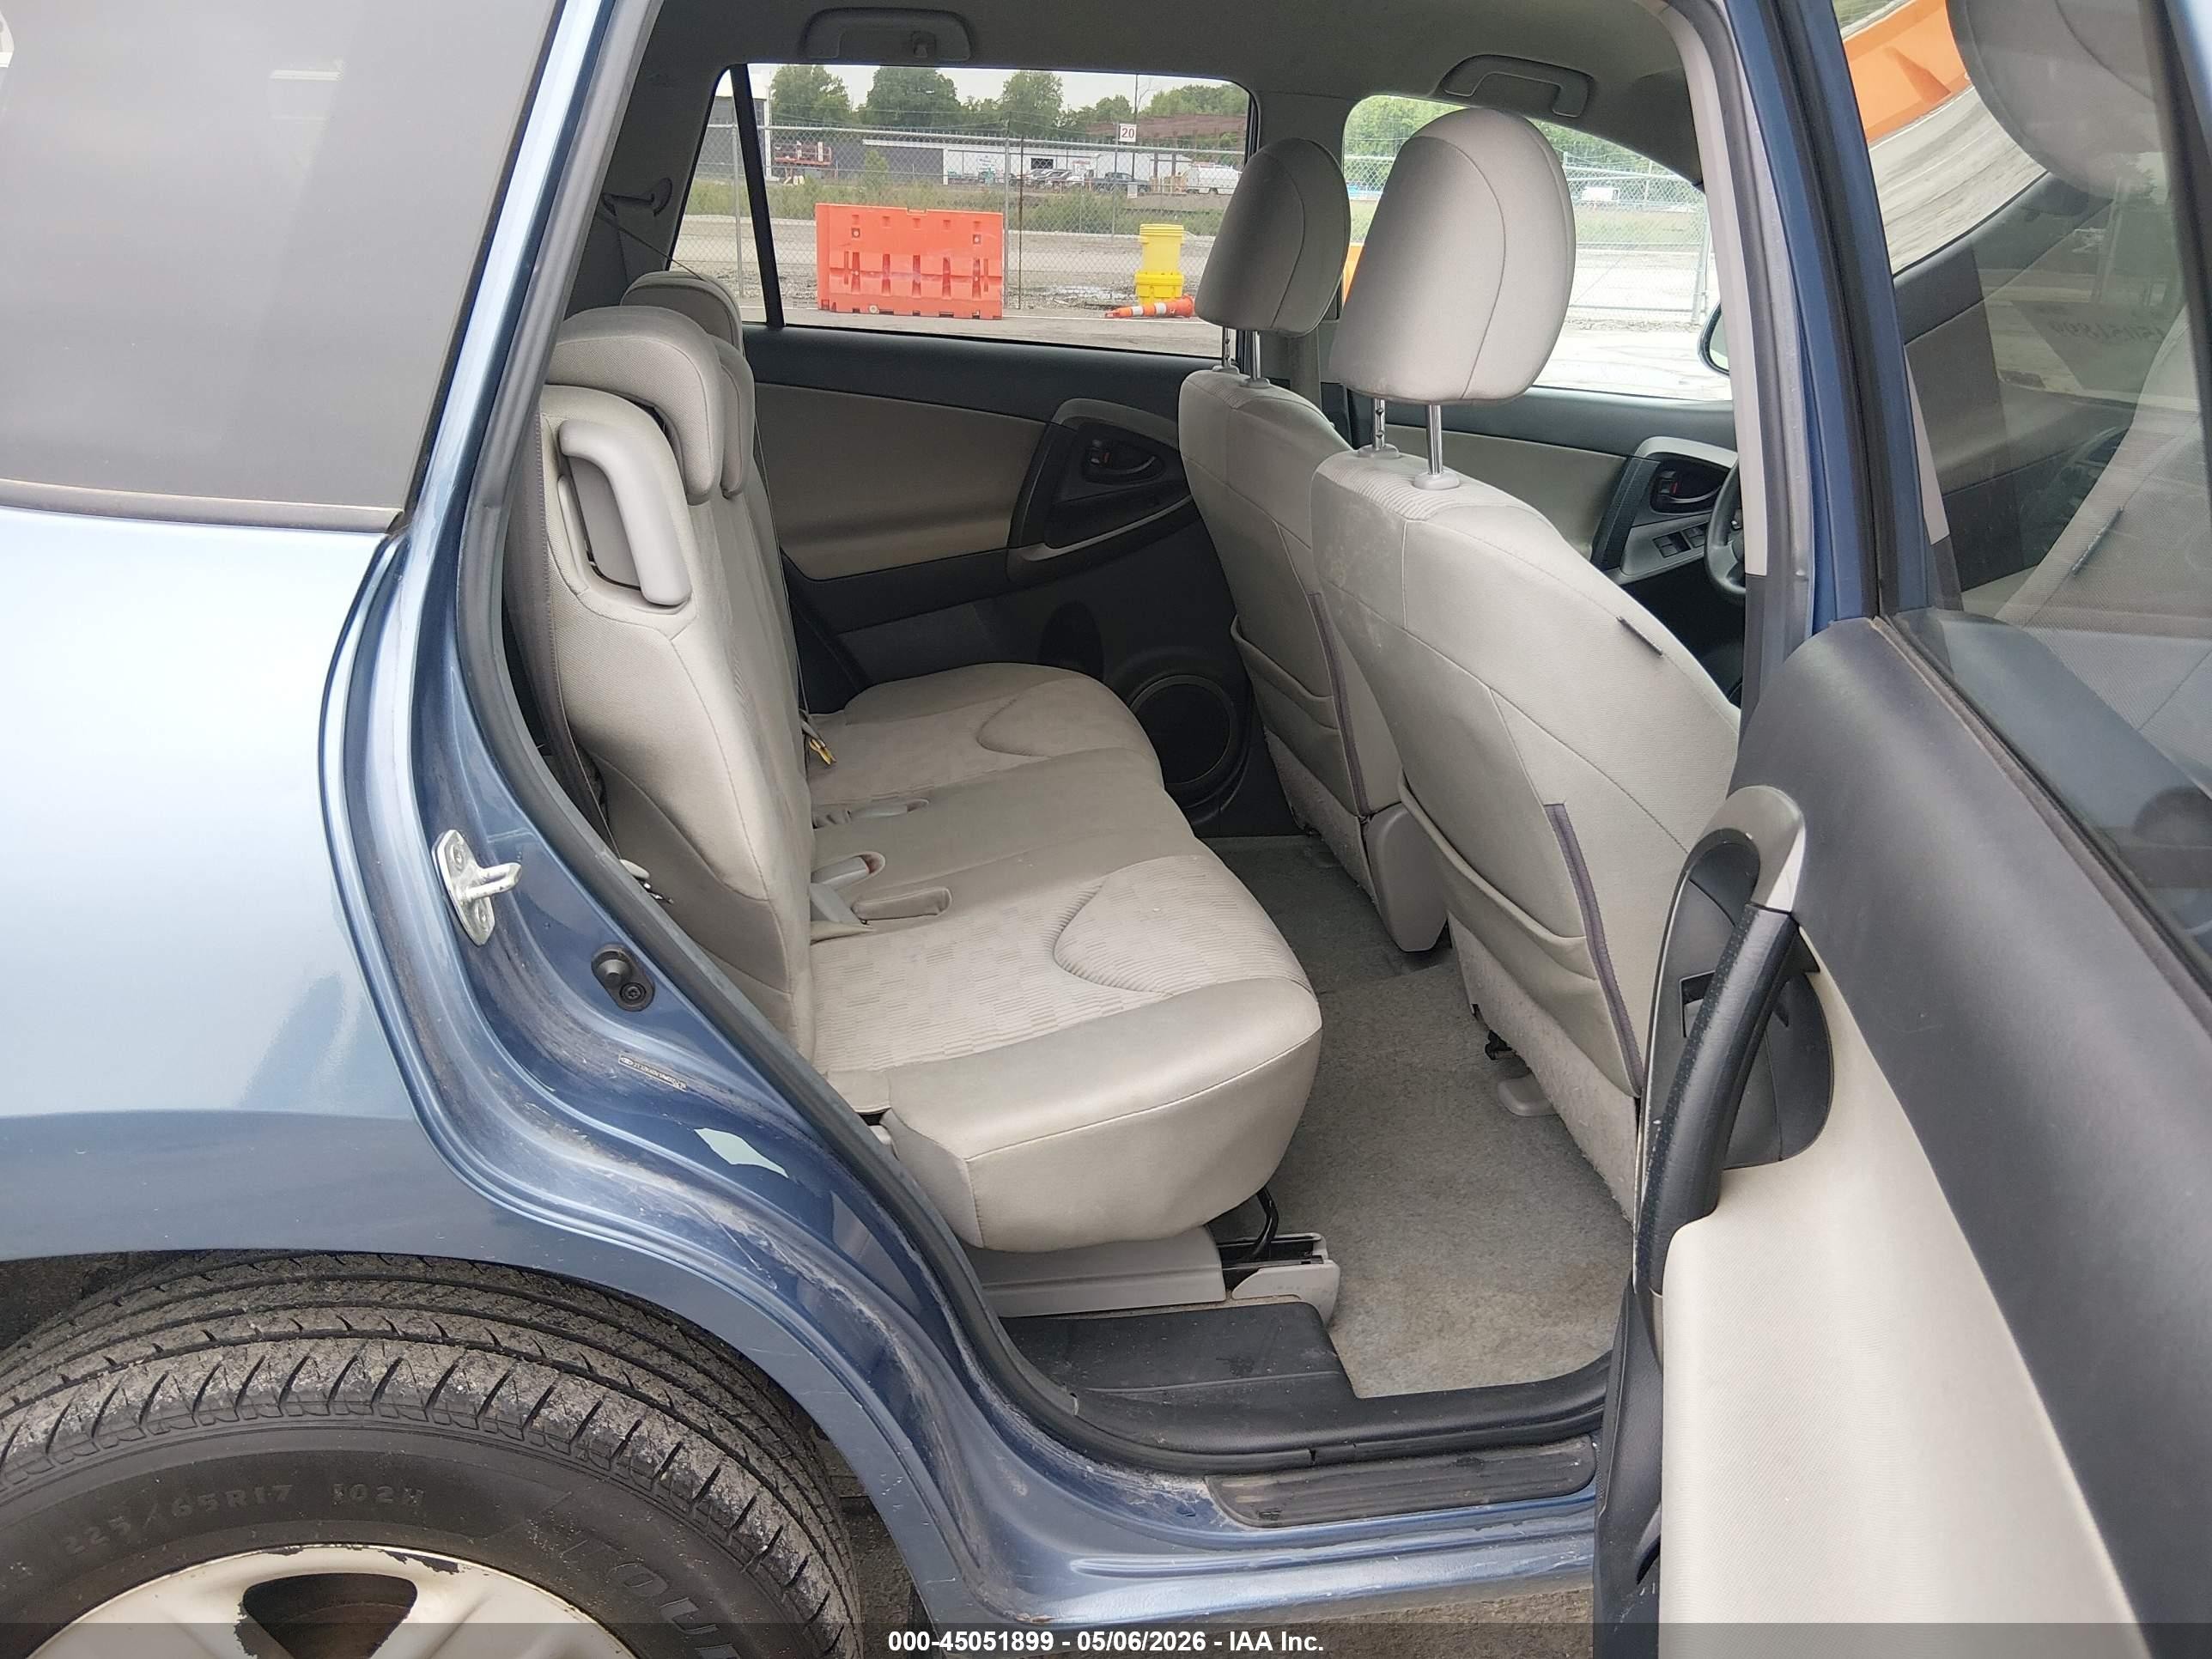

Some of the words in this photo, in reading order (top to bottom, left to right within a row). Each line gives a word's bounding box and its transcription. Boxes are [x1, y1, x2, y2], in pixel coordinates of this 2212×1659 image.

[1121, 127, 1135, 139] 20
[62, 1484, 293, 1556] 225/65R17
[331, 1482, 426, 1507] 102H
